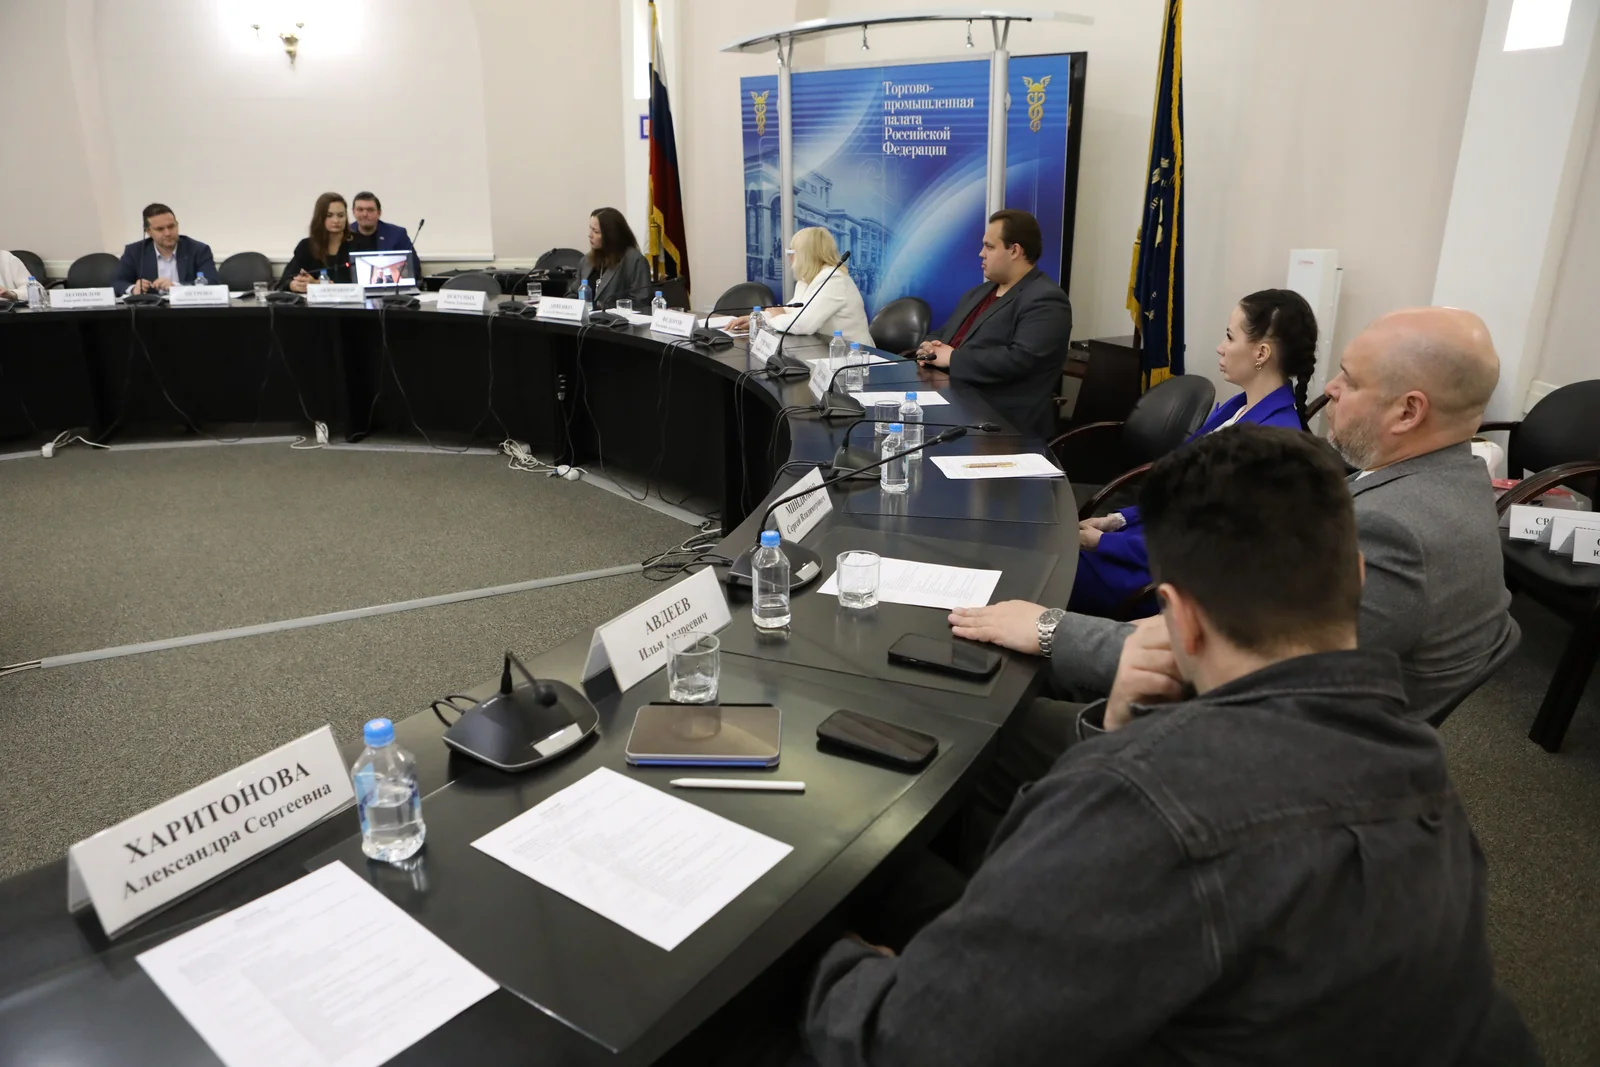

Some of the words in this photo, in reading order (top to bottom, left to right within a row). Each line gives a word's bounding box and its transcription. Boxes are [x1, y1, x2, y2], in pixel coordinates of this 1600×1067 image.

[882, 81, 934, 98] Торгово-
[884, 98, 974, 114] промышленная
[884, 115, 922, 125] палата
[884, 126, 951, 140] Российской
[882, 141, 947, 159] Федерации
[645, 597, 691, 635] АВДЕЕВ
[639, 640, 665, 662] Илья
[123, 762, 311, 864] ХАРИТОНОВА
[123, 830, 242, 900] Александра
[244, 783, 333, 834] Сергеевна
